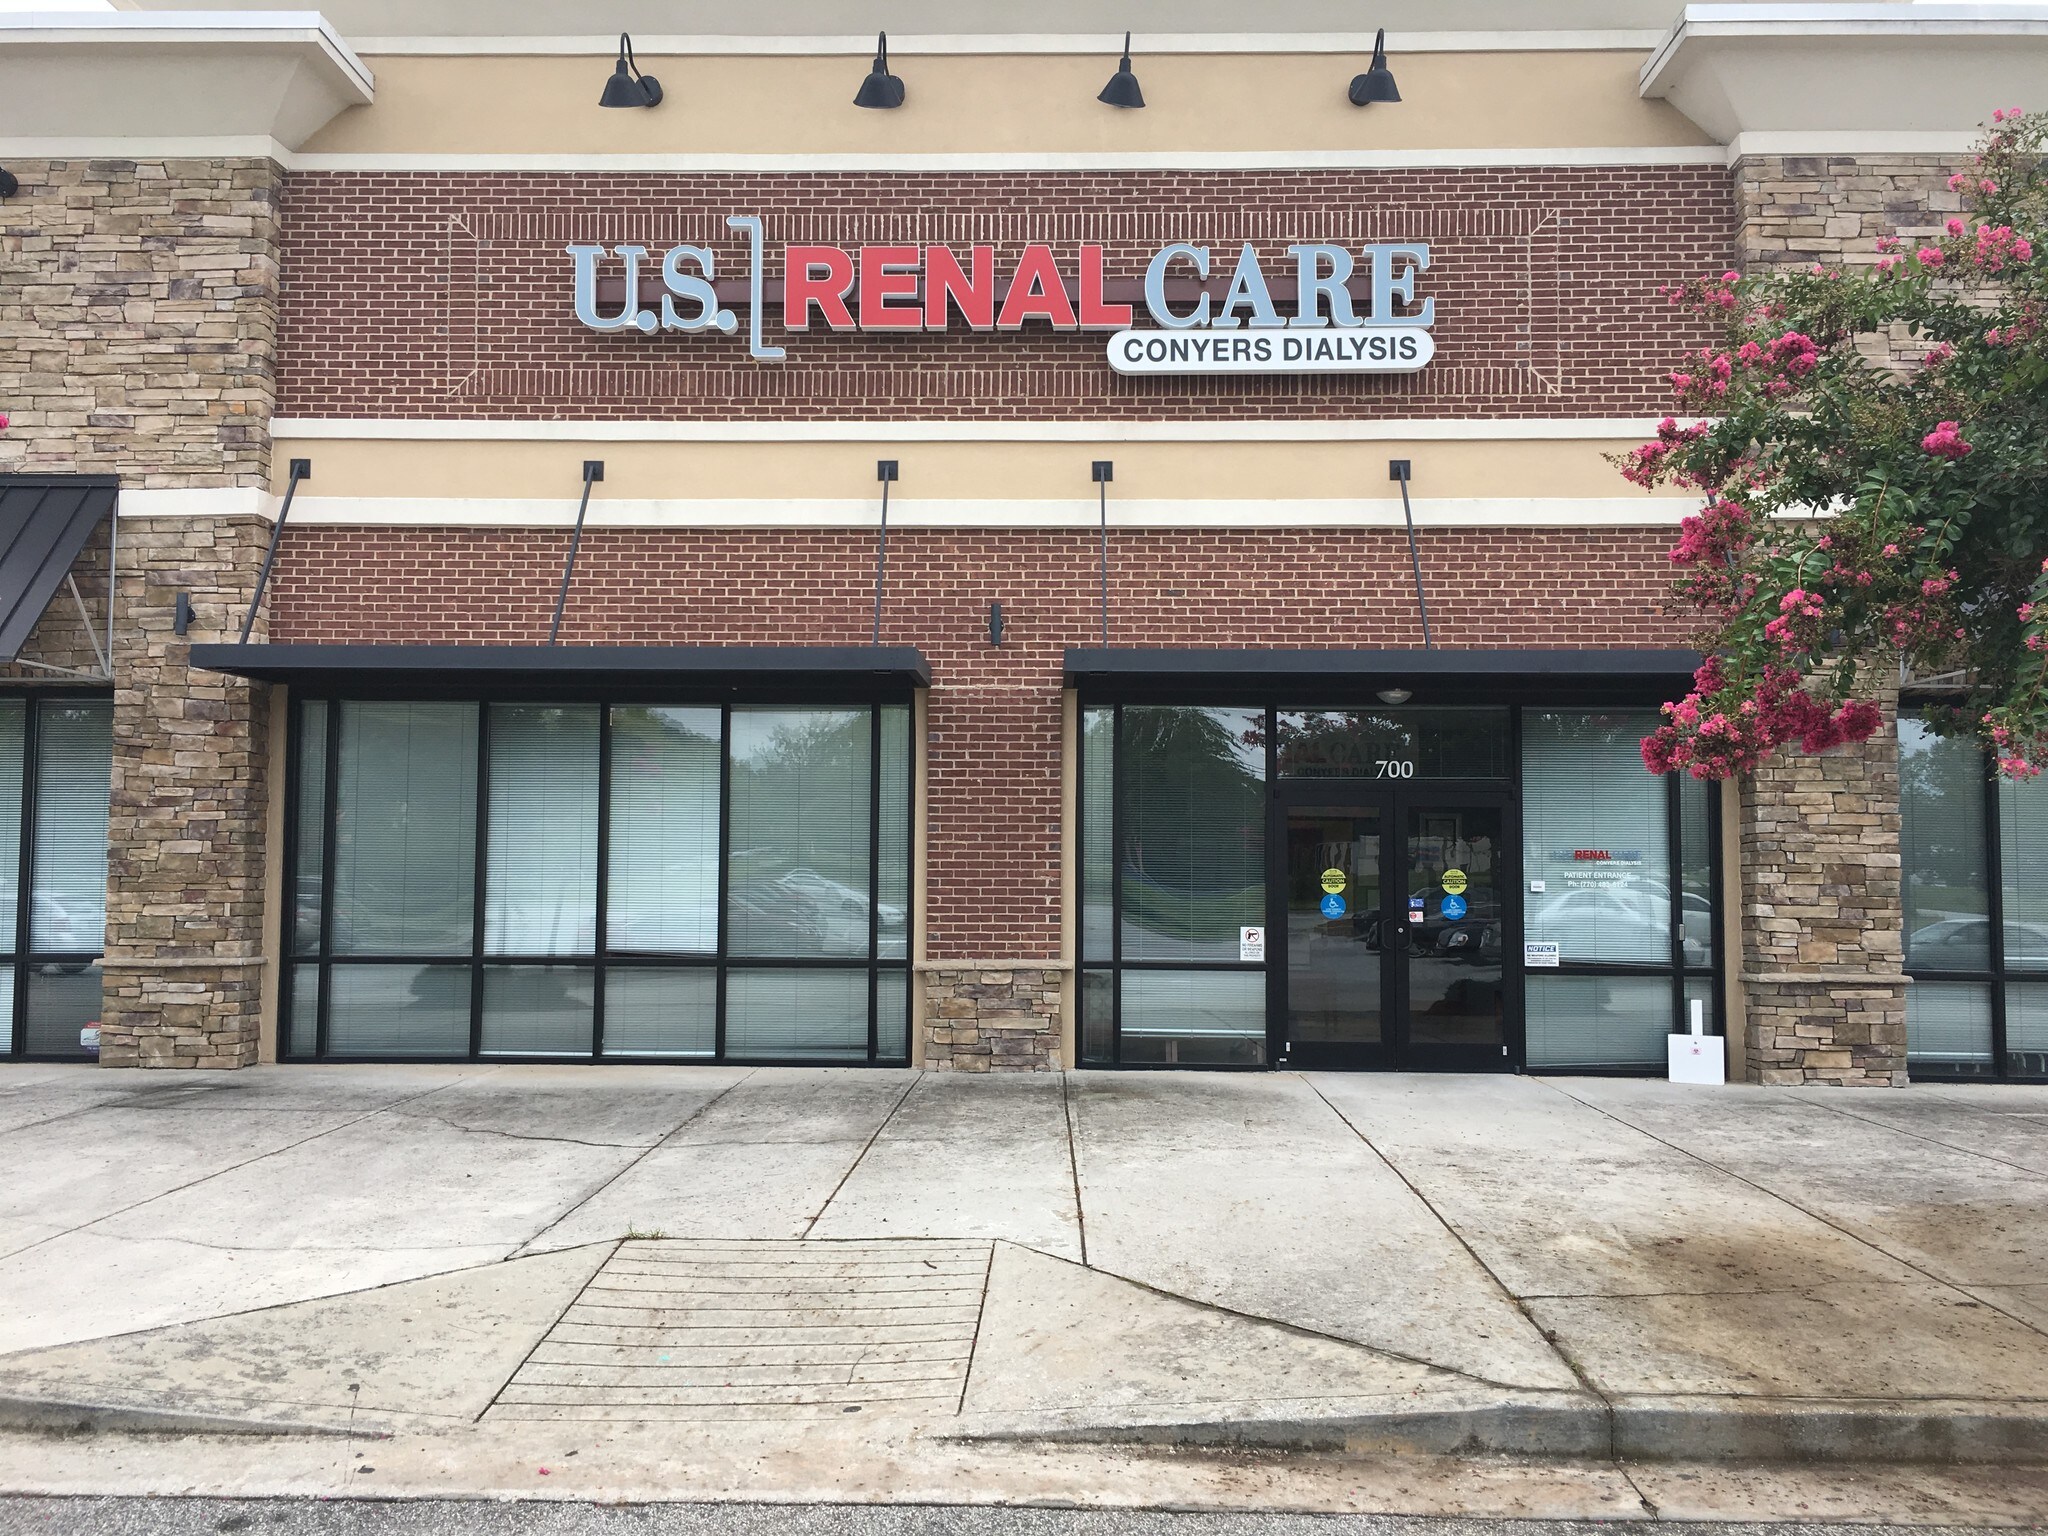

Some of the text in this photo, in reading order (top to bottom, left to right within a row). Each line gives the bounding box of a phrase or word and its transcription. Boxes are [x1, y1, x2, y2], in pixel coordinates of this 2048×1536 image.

[566, 243, 1435, 333] U.S. RENAL CARE
[1123, 336, 1418, 362] CONYERS DIALYSIS
[1375, 760, 1414, 779] 700
[1574, 850, 1612, 860] RENAL
